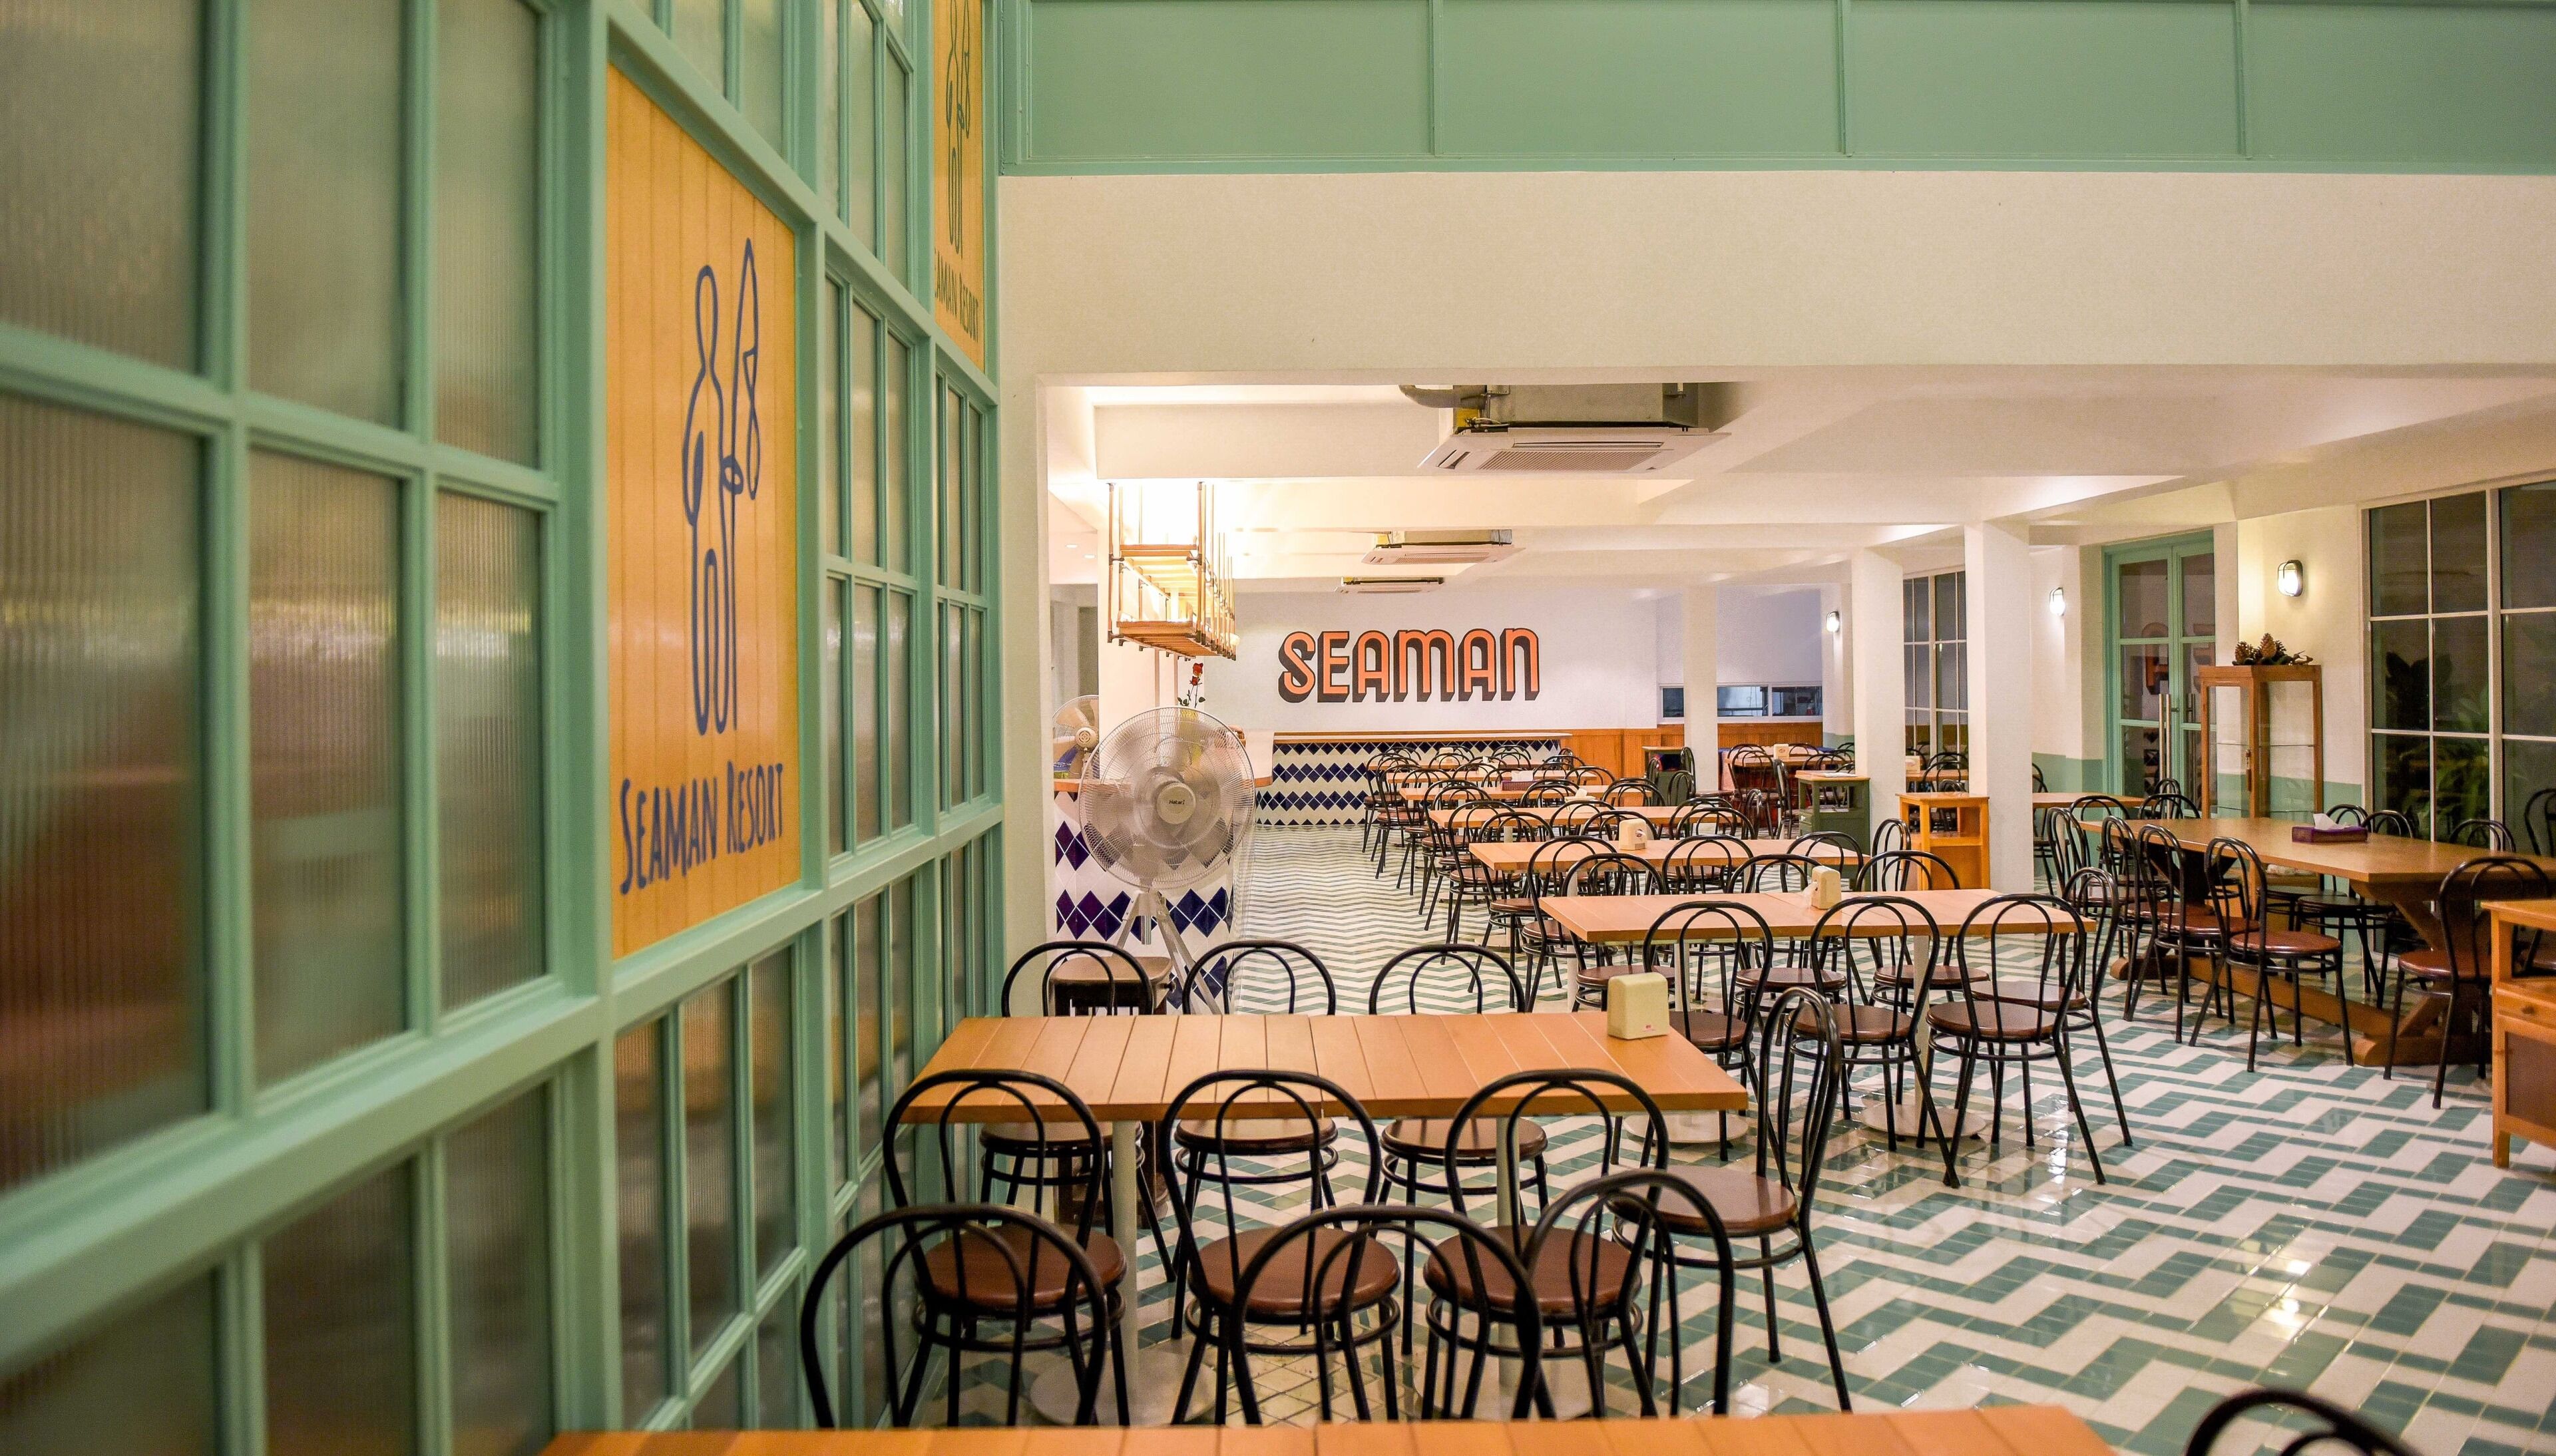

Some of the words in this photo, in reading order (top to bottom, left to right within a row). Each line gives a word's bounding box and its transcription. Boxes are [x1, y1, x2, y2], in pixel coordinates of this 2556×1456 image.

[934, 247, 957, 319] AMAN
[959, 272, 978, 343] RESORT
[1278, 628, 1540, 703] SEAMAN
[620, 777, 718, 895] SEAMAN
[726, 760, 783, 854] RESORT
